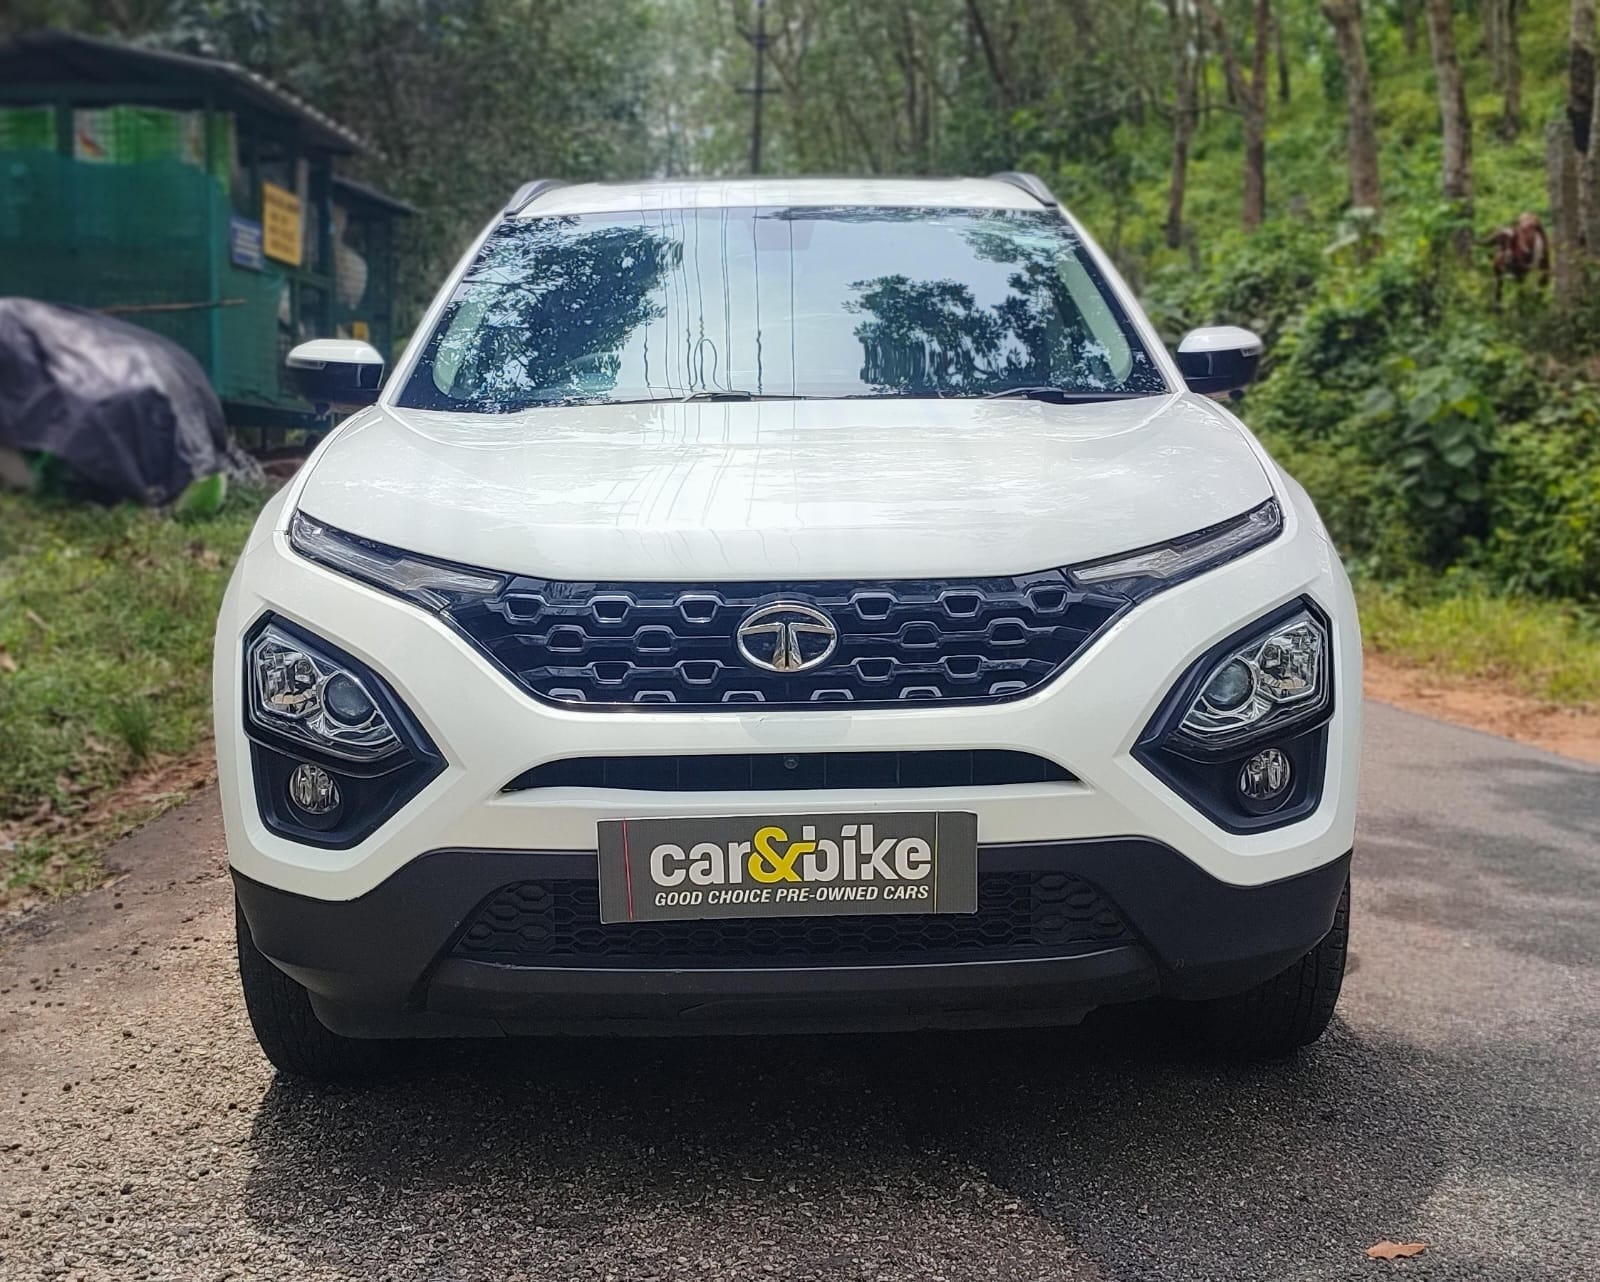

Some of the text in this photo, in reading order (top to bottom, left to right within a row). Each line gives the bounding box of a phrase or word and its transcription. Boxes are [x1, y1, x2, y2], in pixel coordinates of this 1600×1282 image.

[650, 824, 932, 886] car&bike
[655, 885, 929, 906] GOOD CHOICE PRE-OWNED CARS
